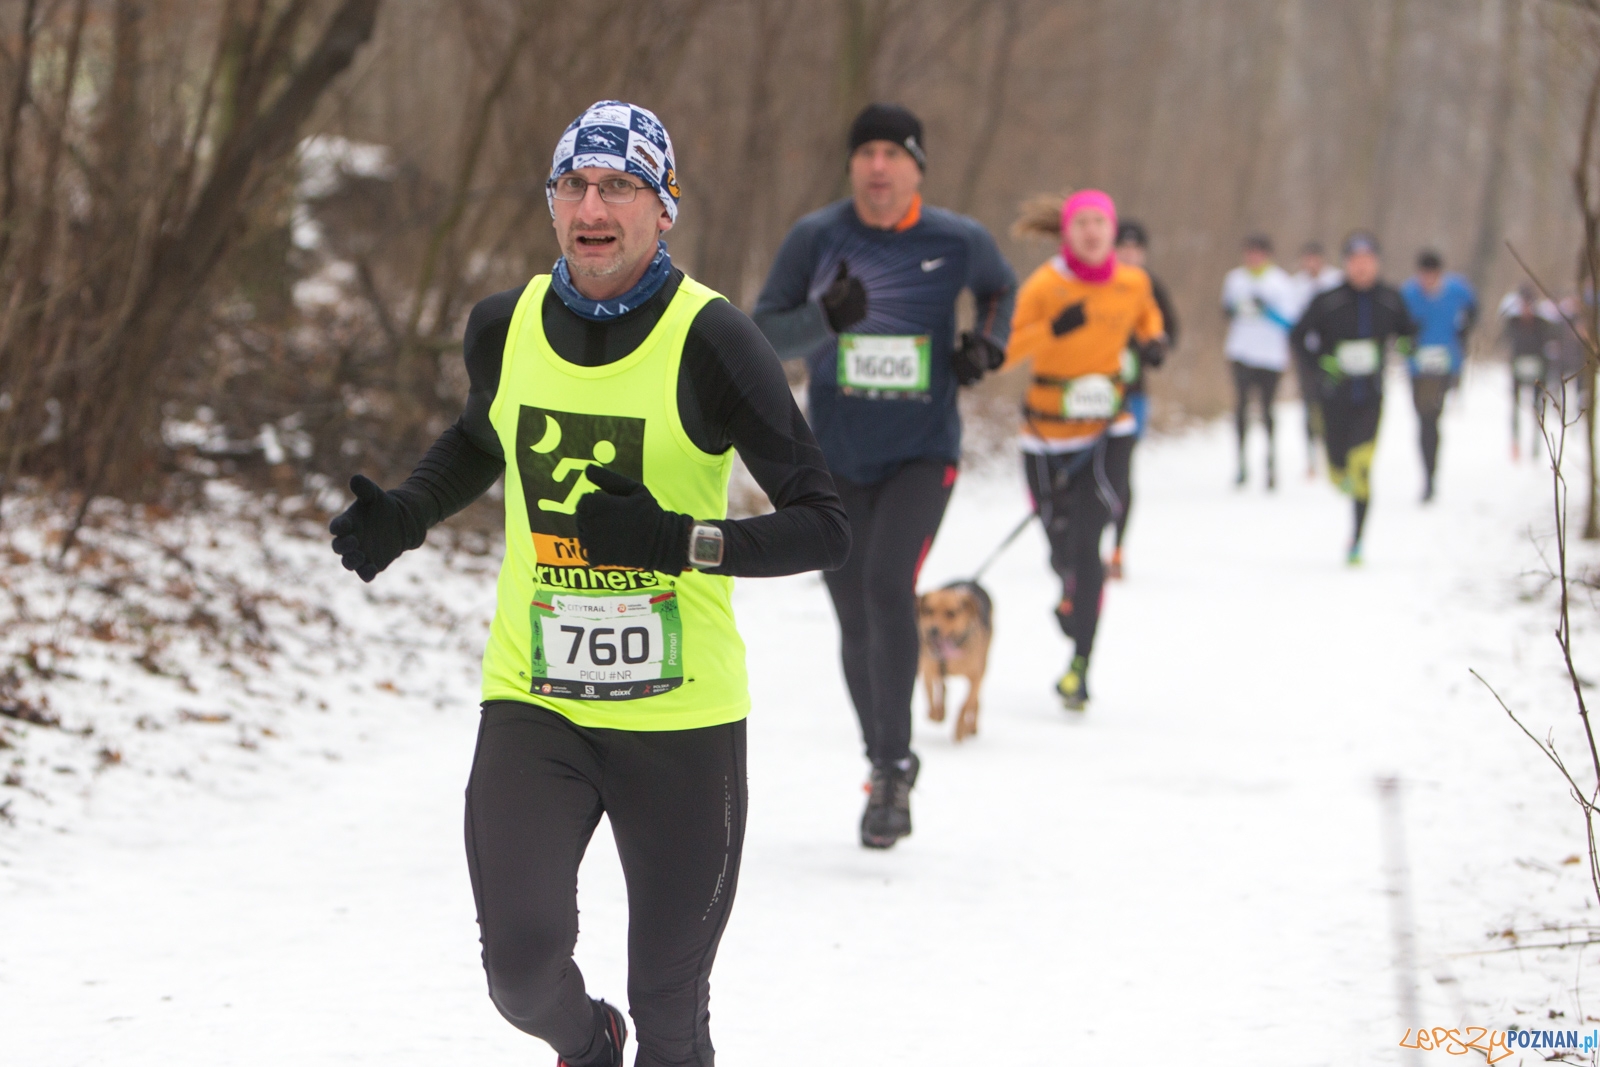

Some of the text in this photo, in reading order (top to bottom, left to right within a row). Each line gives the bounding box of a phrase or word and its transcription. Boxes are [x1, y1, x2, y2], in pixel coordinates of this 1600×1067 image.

[854, 354, 913, 378] 1606
[537, 565, 657, 590] runners
[560, 625, 650, 666] 760
[668, 633, 677, 666] Poznań
[580, 670, 632, 680] PICIU #NR
